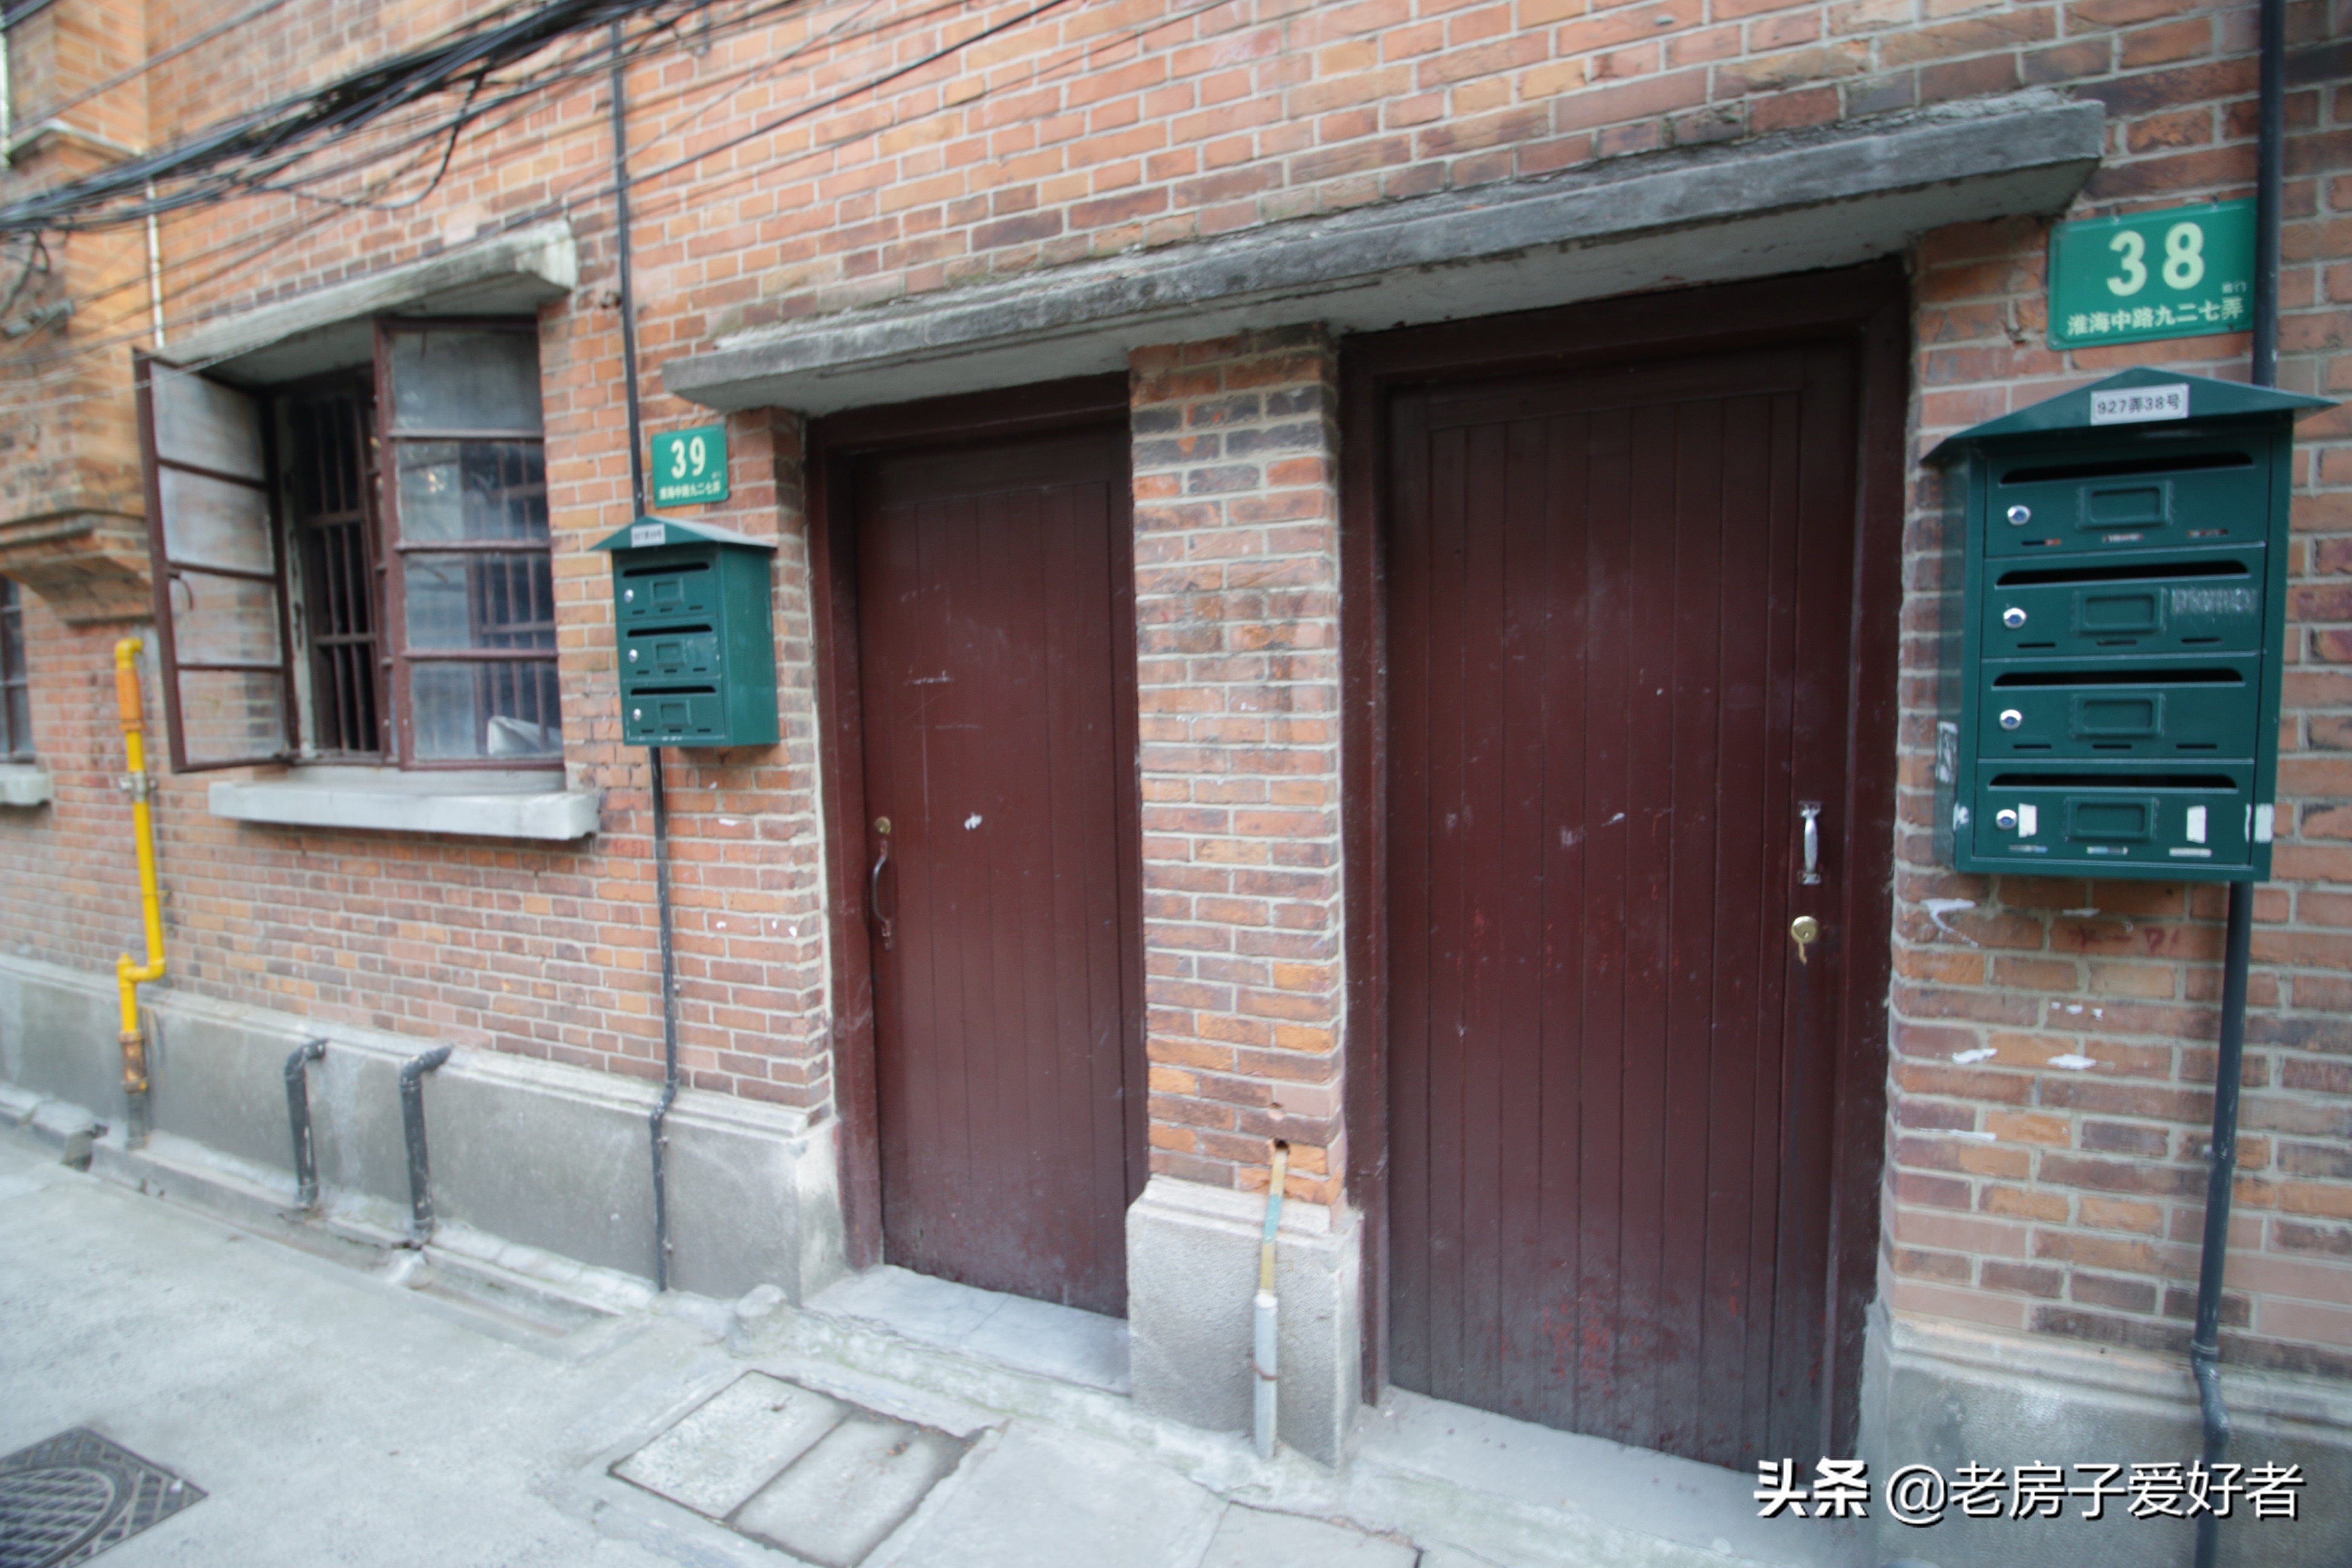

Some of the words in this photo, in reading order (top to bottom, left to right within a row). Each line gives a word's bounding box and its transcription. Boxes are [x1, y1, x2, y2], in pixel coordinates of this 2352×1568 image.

[2107, 221, 2205, 297] 38
[2067, 296, 2244, 336] 淮海中路九二七弄
[2097, 393, 2181, 414] 927弄38号
[671, 435, 706, 479] 39
